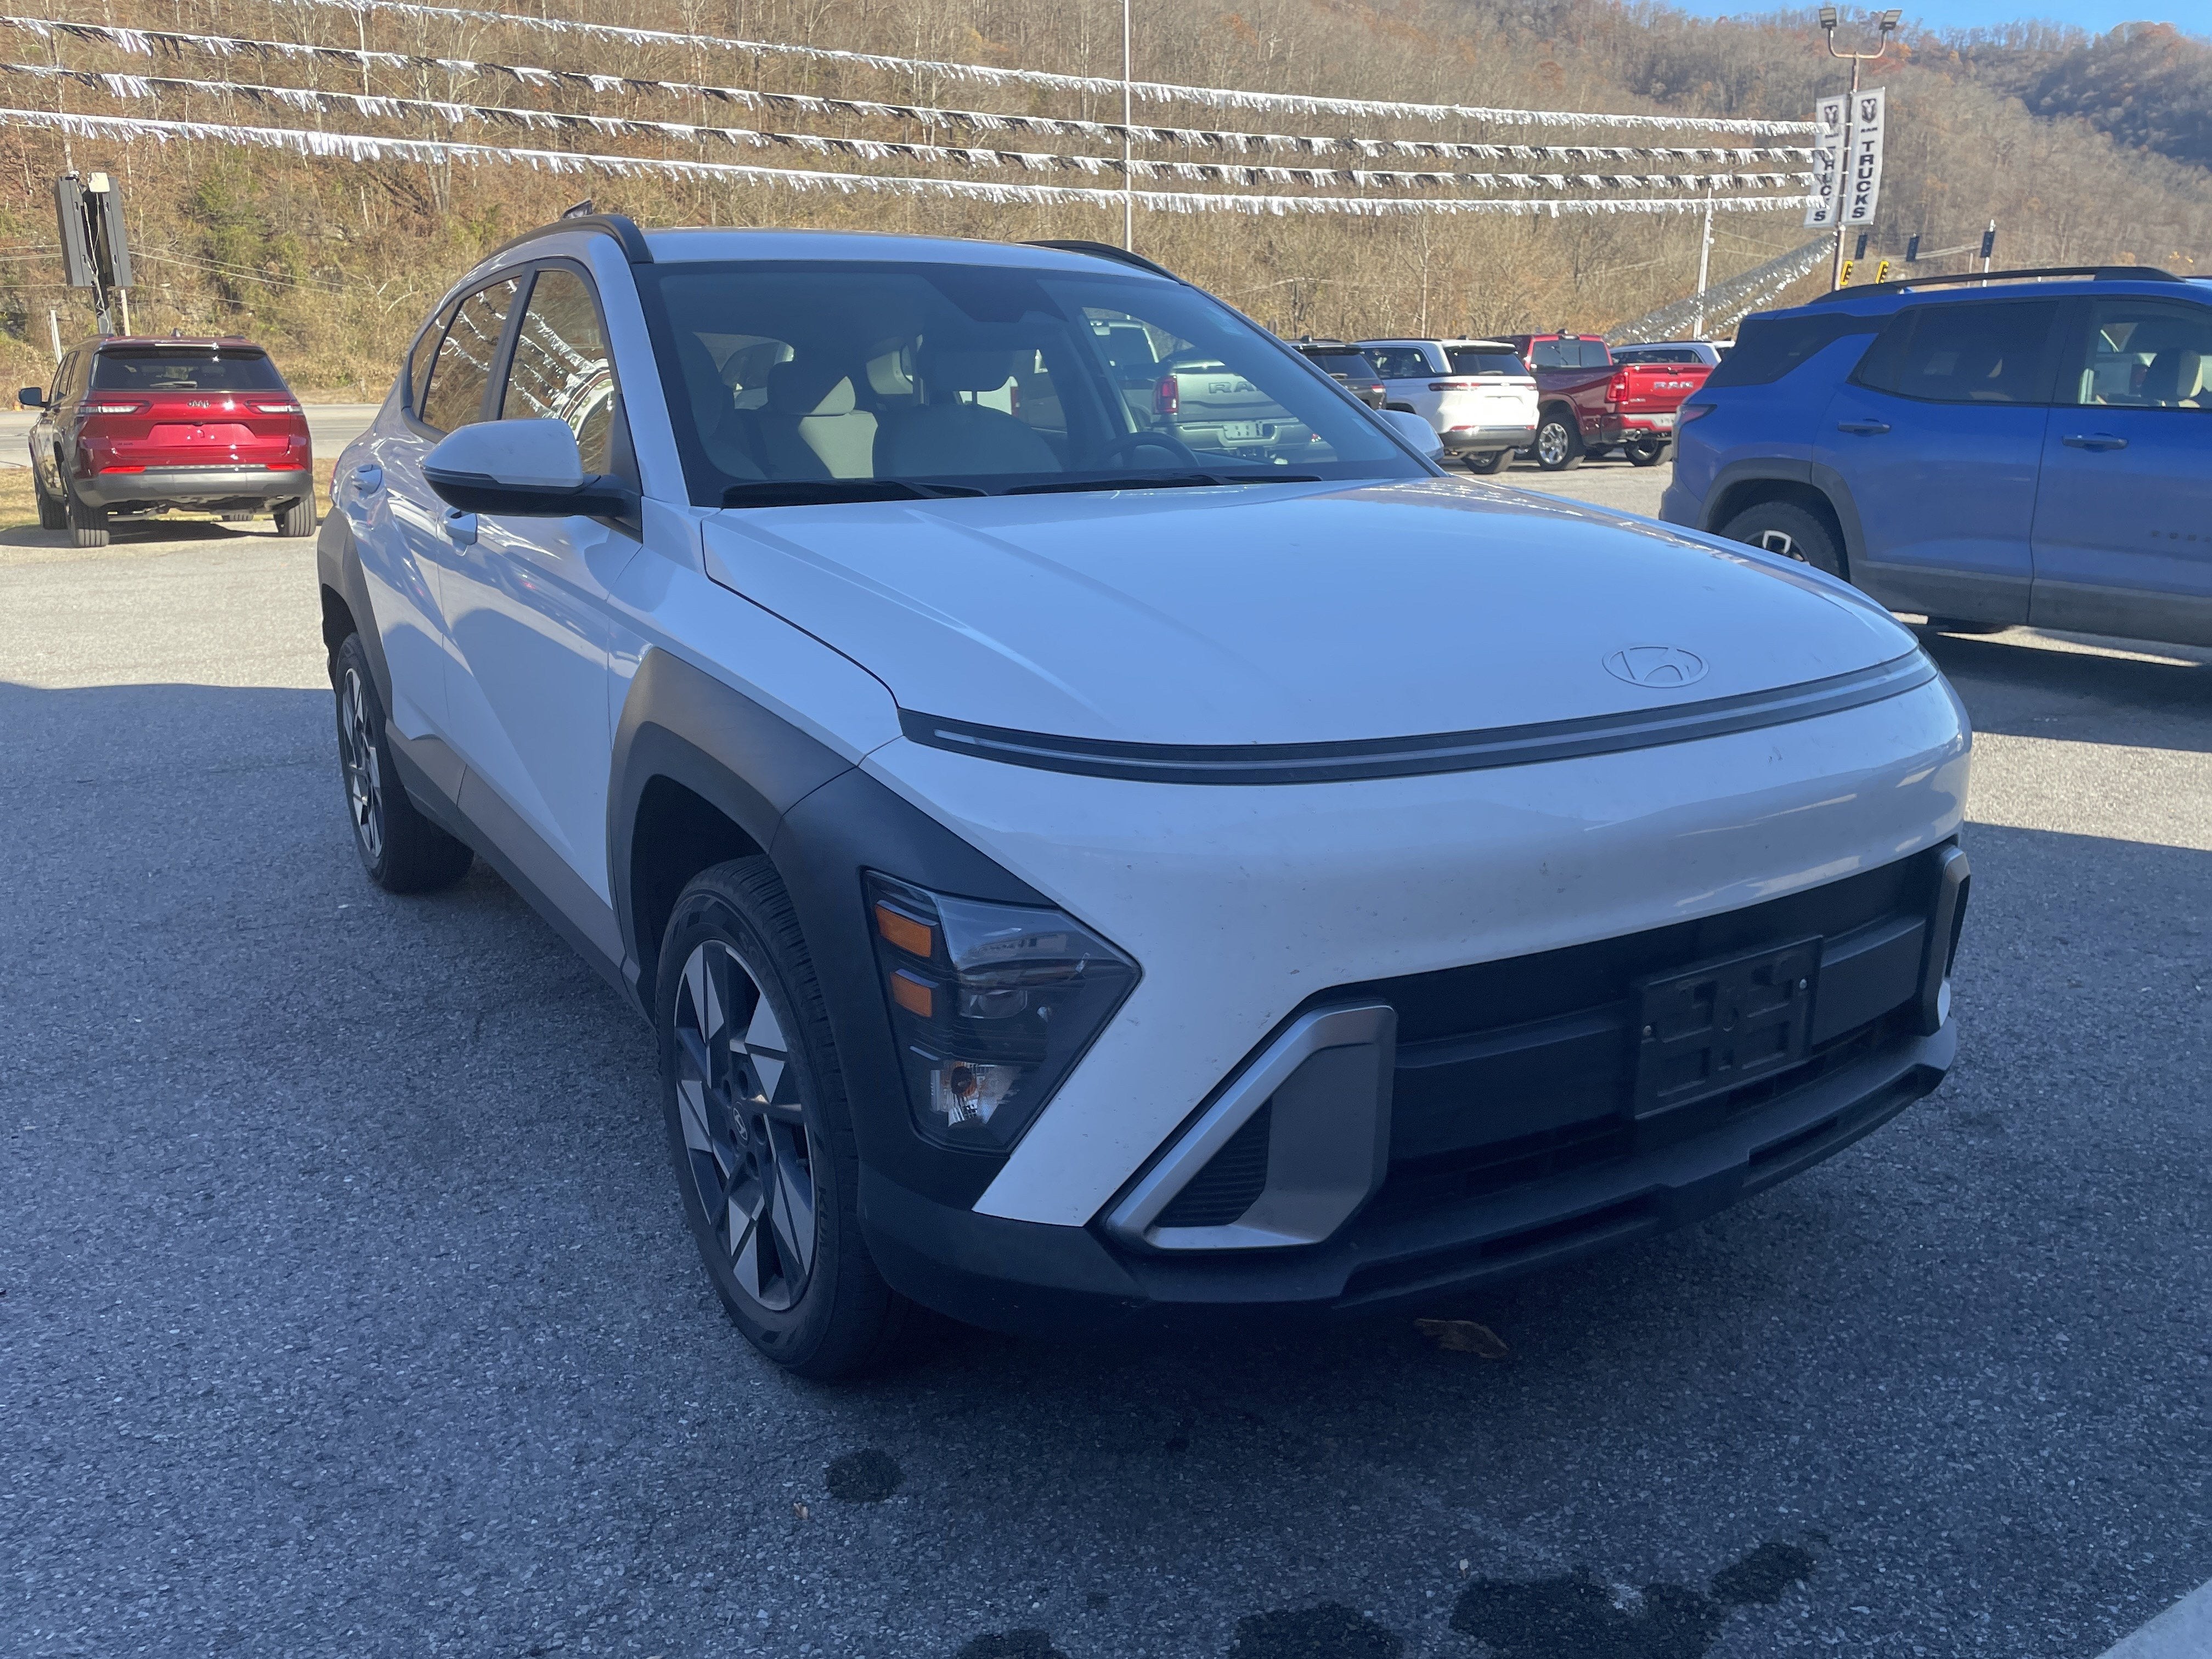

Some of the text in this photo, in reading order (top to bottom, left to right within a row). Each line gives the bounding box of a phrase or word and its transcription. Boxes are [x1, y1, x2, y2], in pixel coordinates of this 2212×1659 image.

[1814, 146, 1836, 221] RUCS
[1852, 140, 1875, 218] TRUCKS
[1208, 381, 1260, 394] RA
[1654, 381, 1694, 390] RAM
